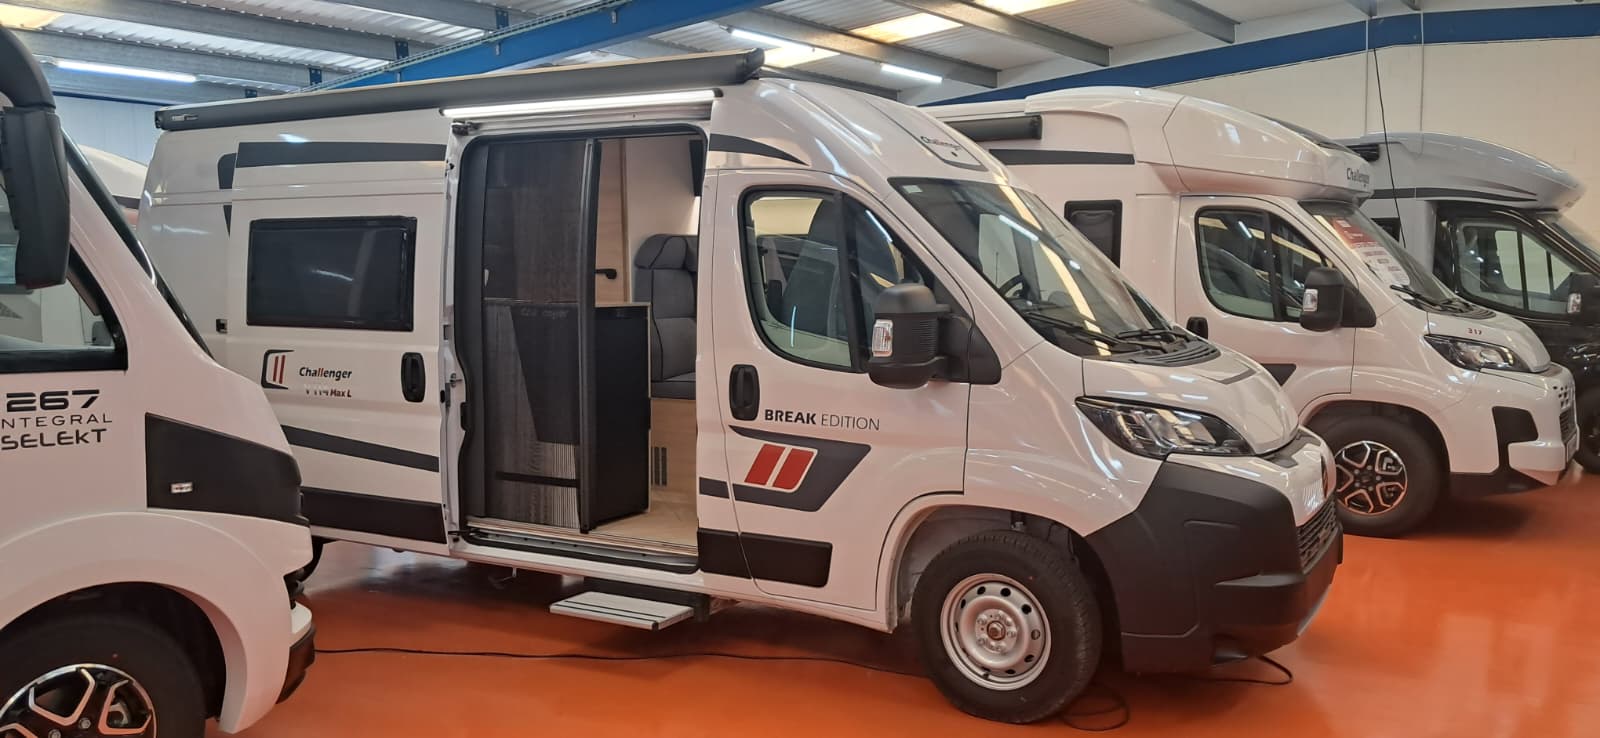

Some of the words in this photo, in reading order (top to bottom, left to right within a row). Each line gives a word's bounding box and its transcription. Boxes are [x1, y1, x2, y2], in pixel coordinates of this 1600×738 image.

[299, 366, 353, 382] Challenger
[6, 389, 100, 413] 267
[330, 389, 346, 397] Max
[347, 390, 352, 398] L
[1, 412, 113, 429] NTEGRAL
[764, 409, 816, 425] BREAK
[821, 413, 881, 431] EDITION
[1, 428, 107, 451] SELEKT
